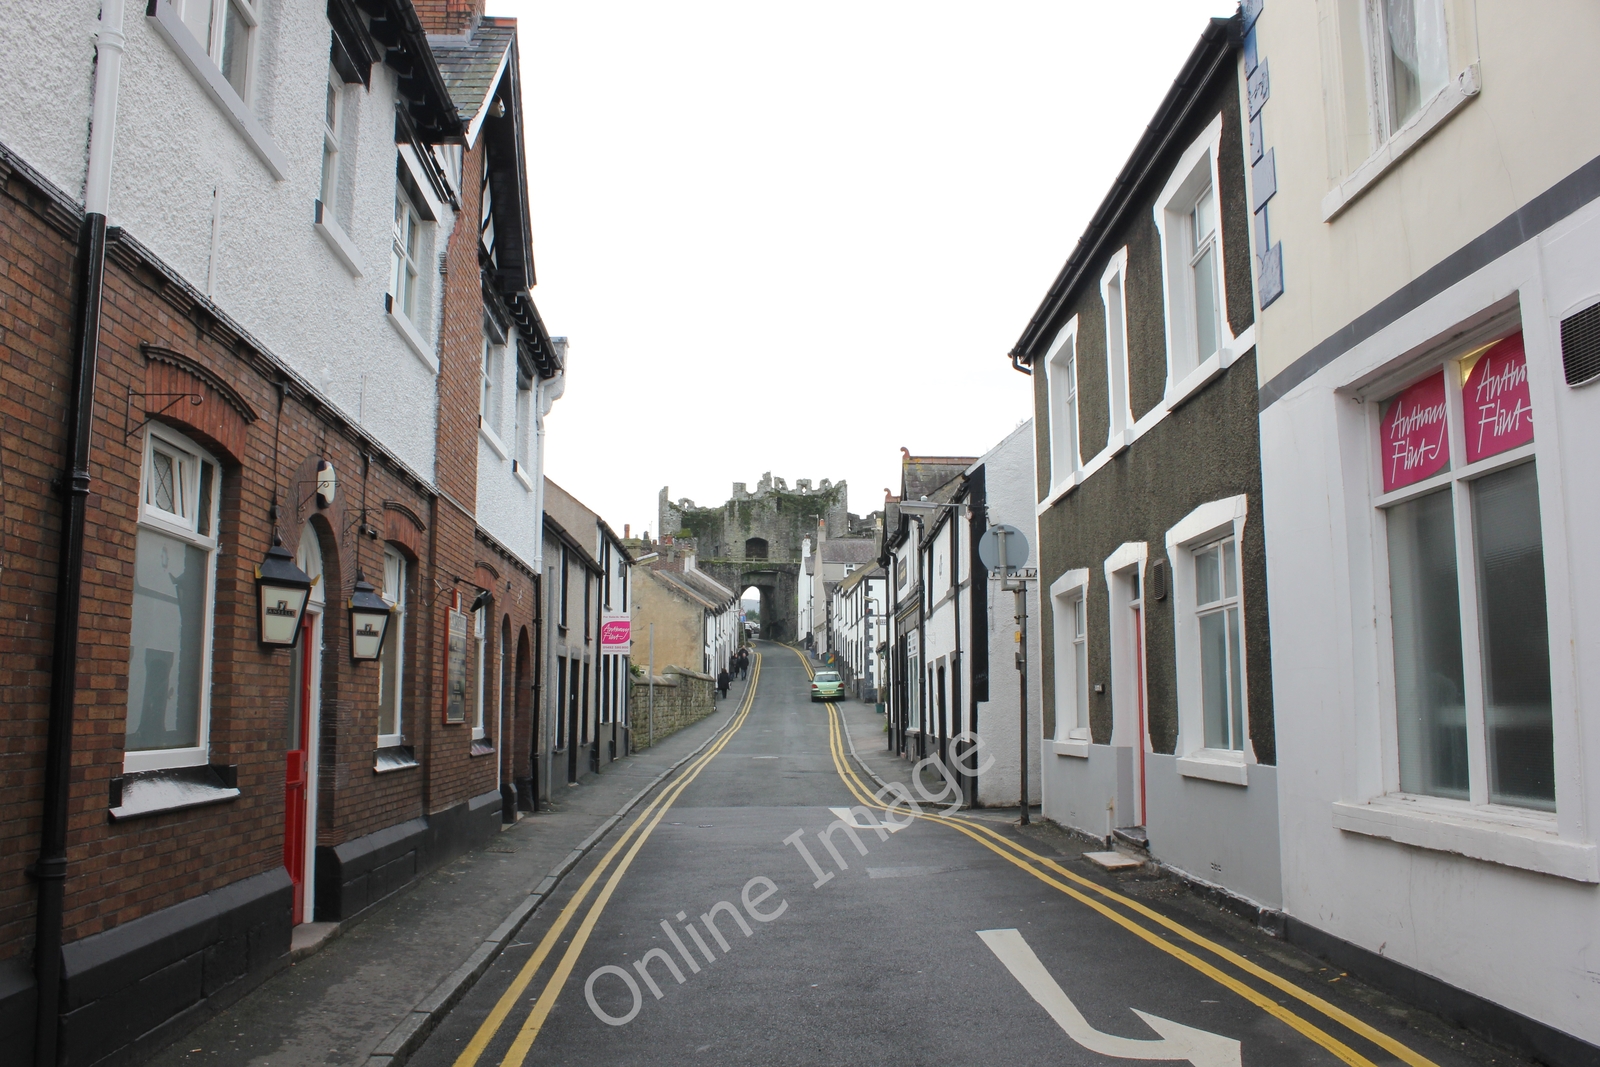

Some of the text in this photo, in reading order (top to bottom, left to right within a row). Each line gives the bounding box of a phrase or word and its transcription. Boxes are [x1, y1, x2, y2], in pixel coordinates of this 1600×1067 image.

[1476, 358, 1528, 403] Antho
[1390, 401, 1447, 460] Anthony
[1478, 398, 1533, 454] Flint
[1392, 437, 1436, 484] Flint
